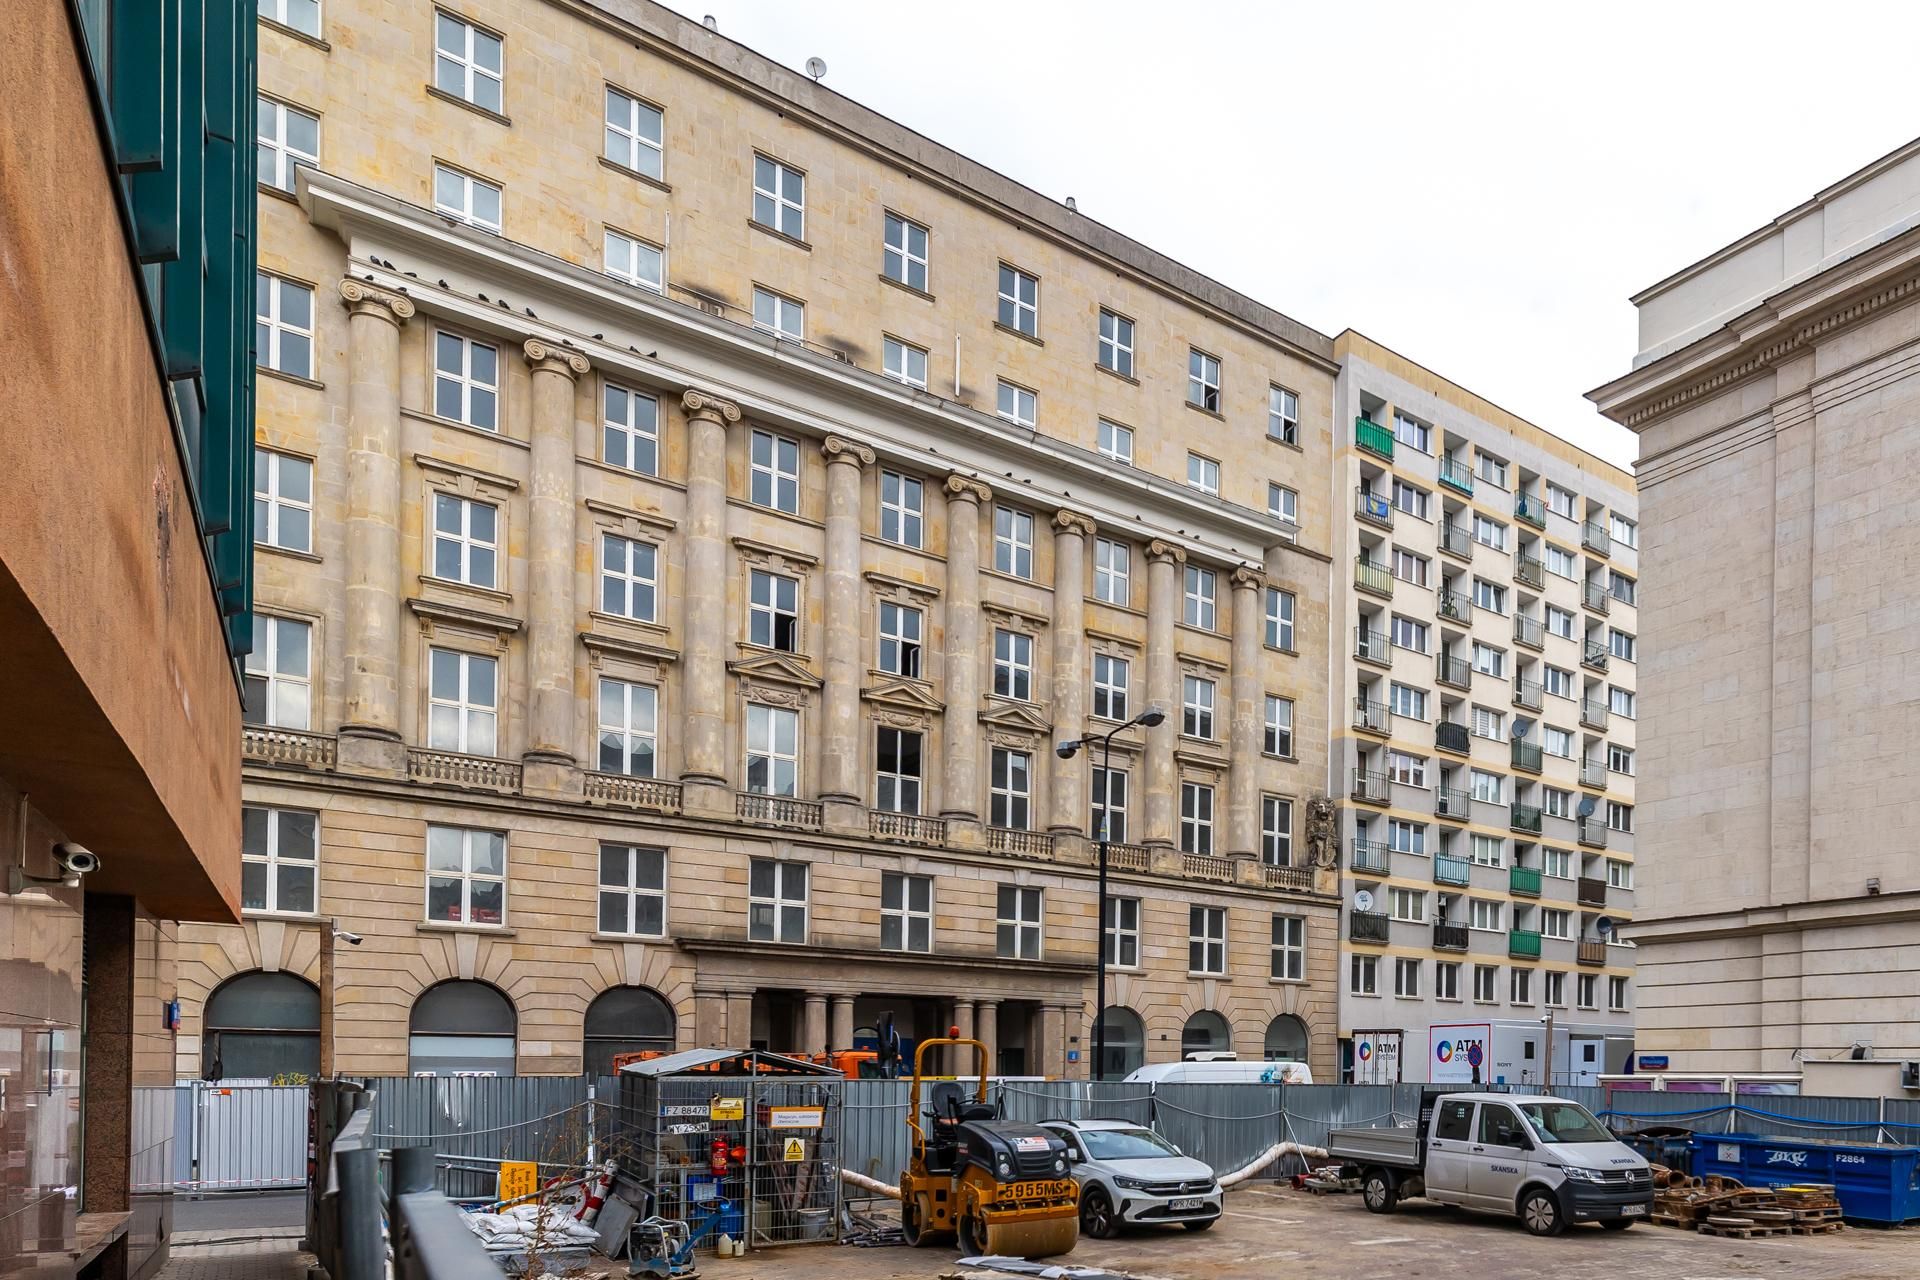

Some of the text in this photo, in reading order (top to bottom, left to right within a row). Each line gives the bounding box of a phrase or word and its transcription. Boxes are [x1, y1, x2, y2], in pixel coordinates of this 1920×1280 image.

[1377, 1044, 1396, 1053] ATM
[1836, 1154, 1865, 1164] F2864
[1491, 1164, 1518, 1174] SKANSKA
